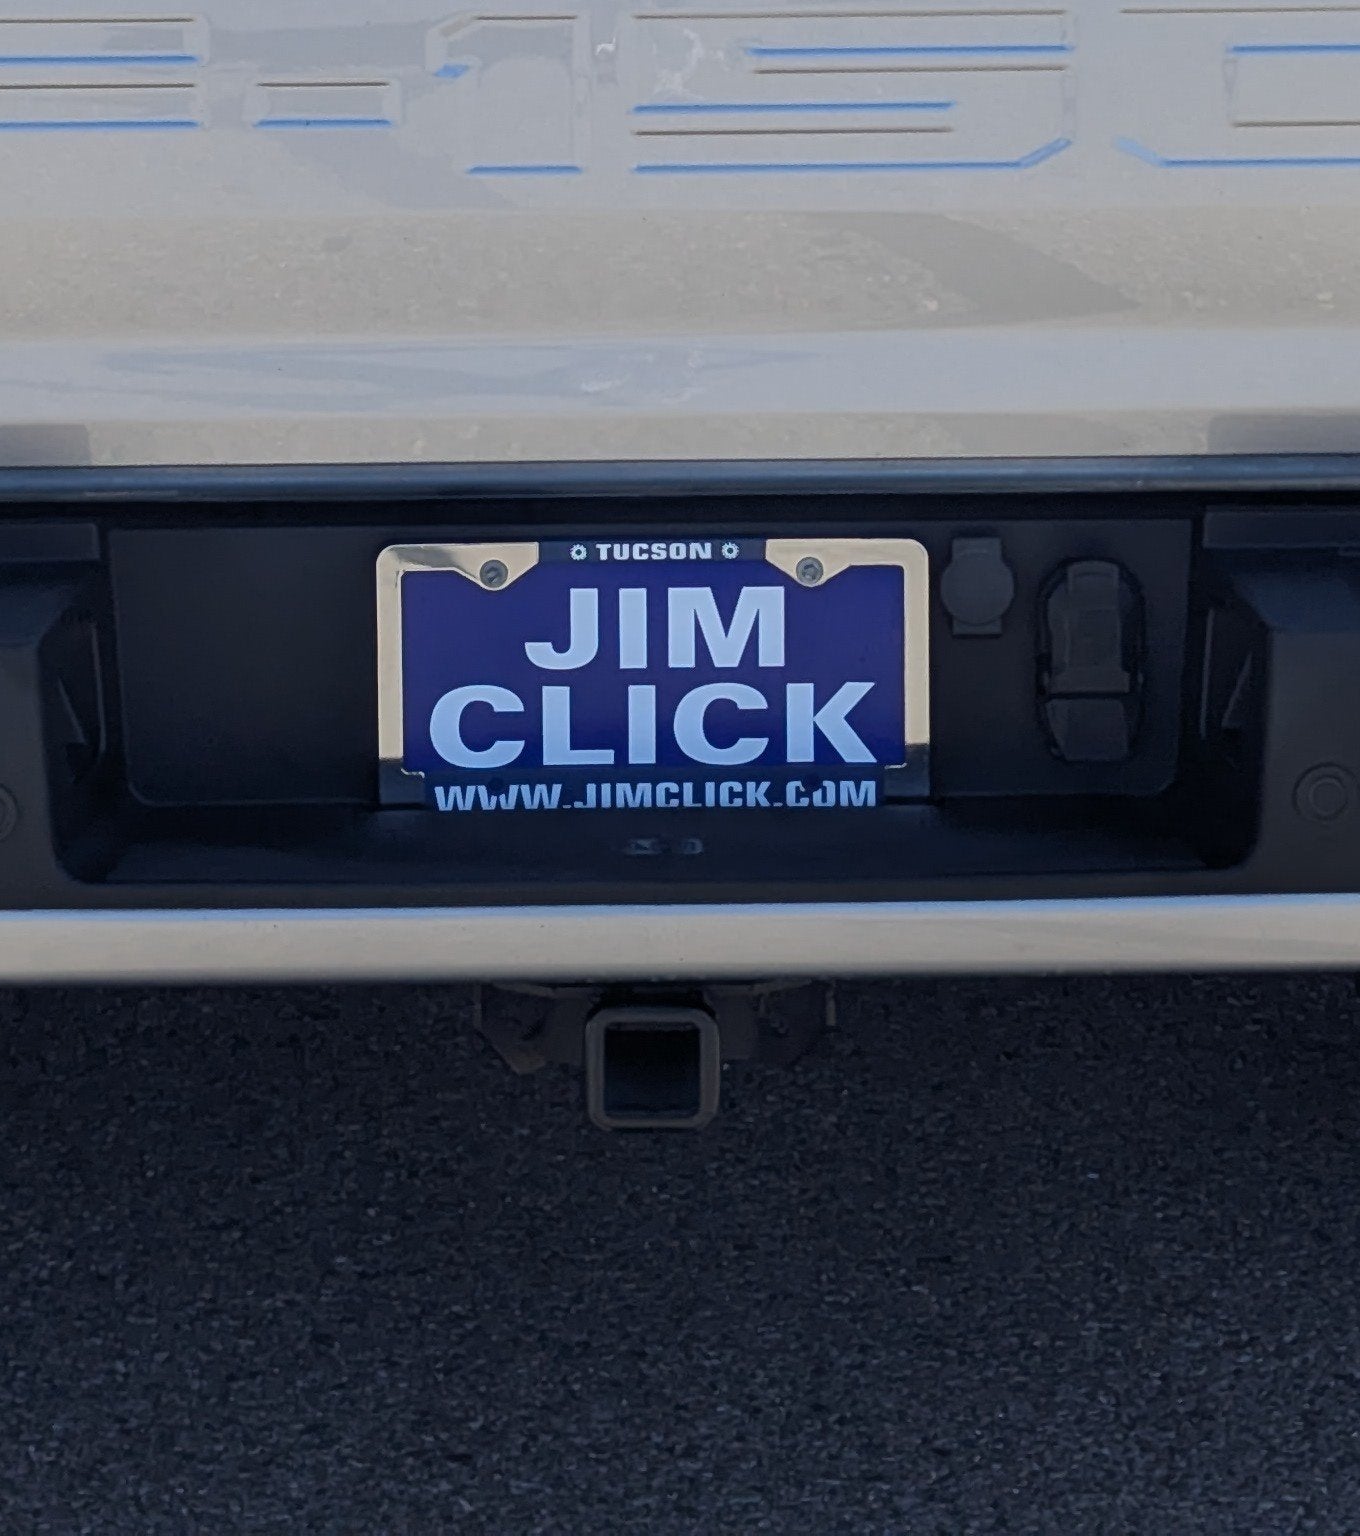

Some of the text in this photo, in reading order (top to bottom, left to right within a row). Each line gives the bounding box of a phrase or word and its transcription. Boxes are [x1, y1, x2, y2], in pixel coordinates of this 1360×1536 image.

[595, 541, 714, 562] TUCSON
[525, 585, 785, 670] JIM
[429, 681, 878, 768] CLICK
[434, 779, 877, 811] WWW.JIMCLICK.COM
